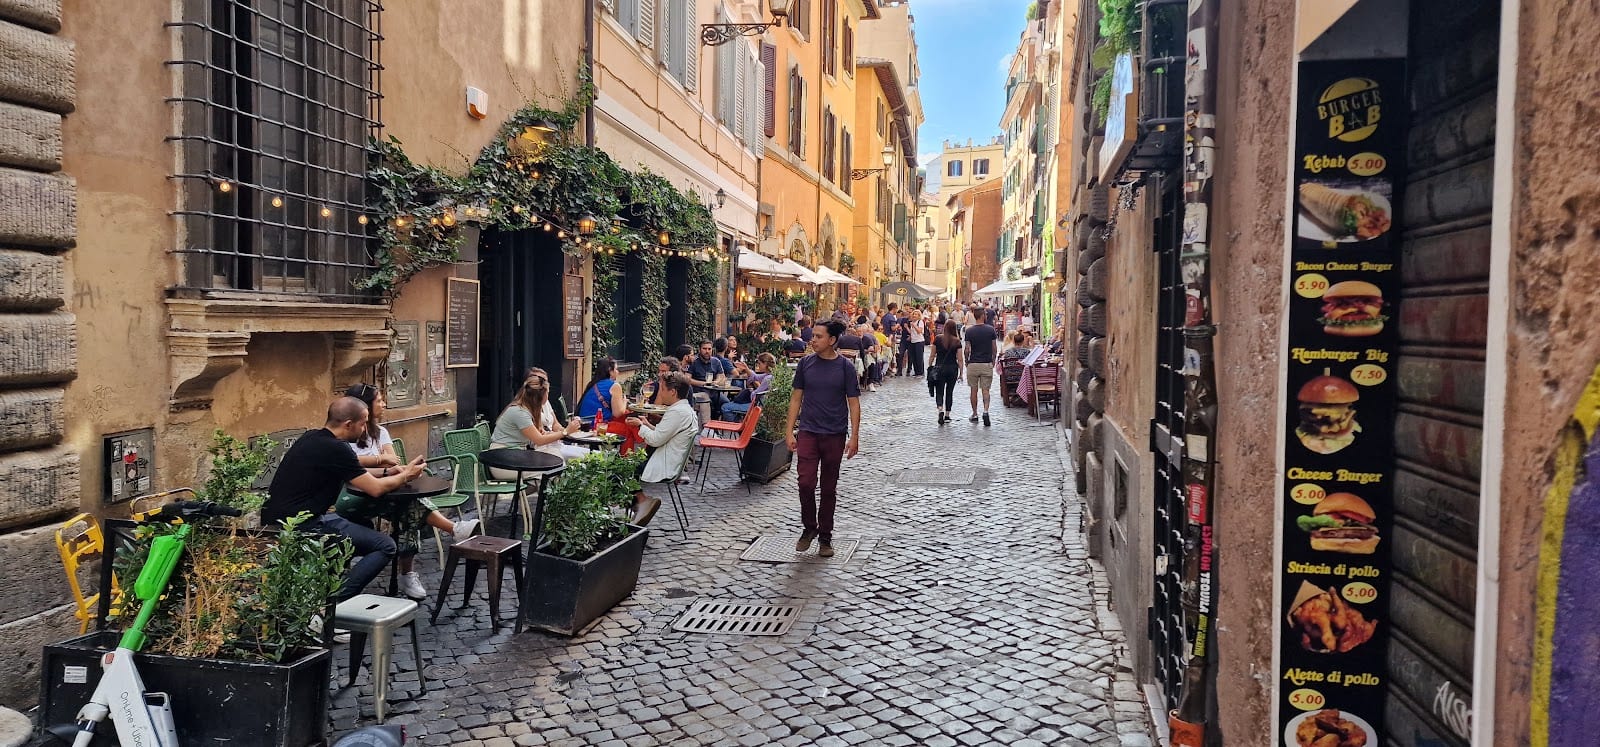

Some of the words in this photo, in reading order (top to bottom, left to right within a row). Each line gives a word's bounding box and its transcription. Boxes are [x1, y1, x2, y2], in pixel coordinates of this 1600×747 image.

[1317, 90, 1383, 120] BURGER
[1303, 154, 1346, 174] Kebab
[1350, 159, 1384, 170] 5.00
[1295, 261, 1325, 271] Bacon
[1326, 261, 1359, 271] Cheese
[1360, 261, 1393, 272] Burger
[1298, 281, 1326, 290] 5.90
[1291, 347, 1360, 364] Hamburger
[1365, 349, 1389, 363] Big
[1355, 370, 1383, 379] 7.50
[1287, 467, 1333, 480] Cheese
[1336, 468, 1383, 484] Burger
[1295, 489, 1325, 499] 5.00
[1287, 561, 1332, 575] Striscia
[1333, 564, 1346, 576] di
[1347, 565, 1381, 578] pollo
[1199, 571, 1211, 614] TEQUILA
[1346, 587, 1376, 598] 5.00
[1283, 667, 1325, 686] Alette
[1326, 670, 1342, 683] di
[1343, 673, 1380, 687] pollo
[1292, 693, 1323, 705] 5.00
